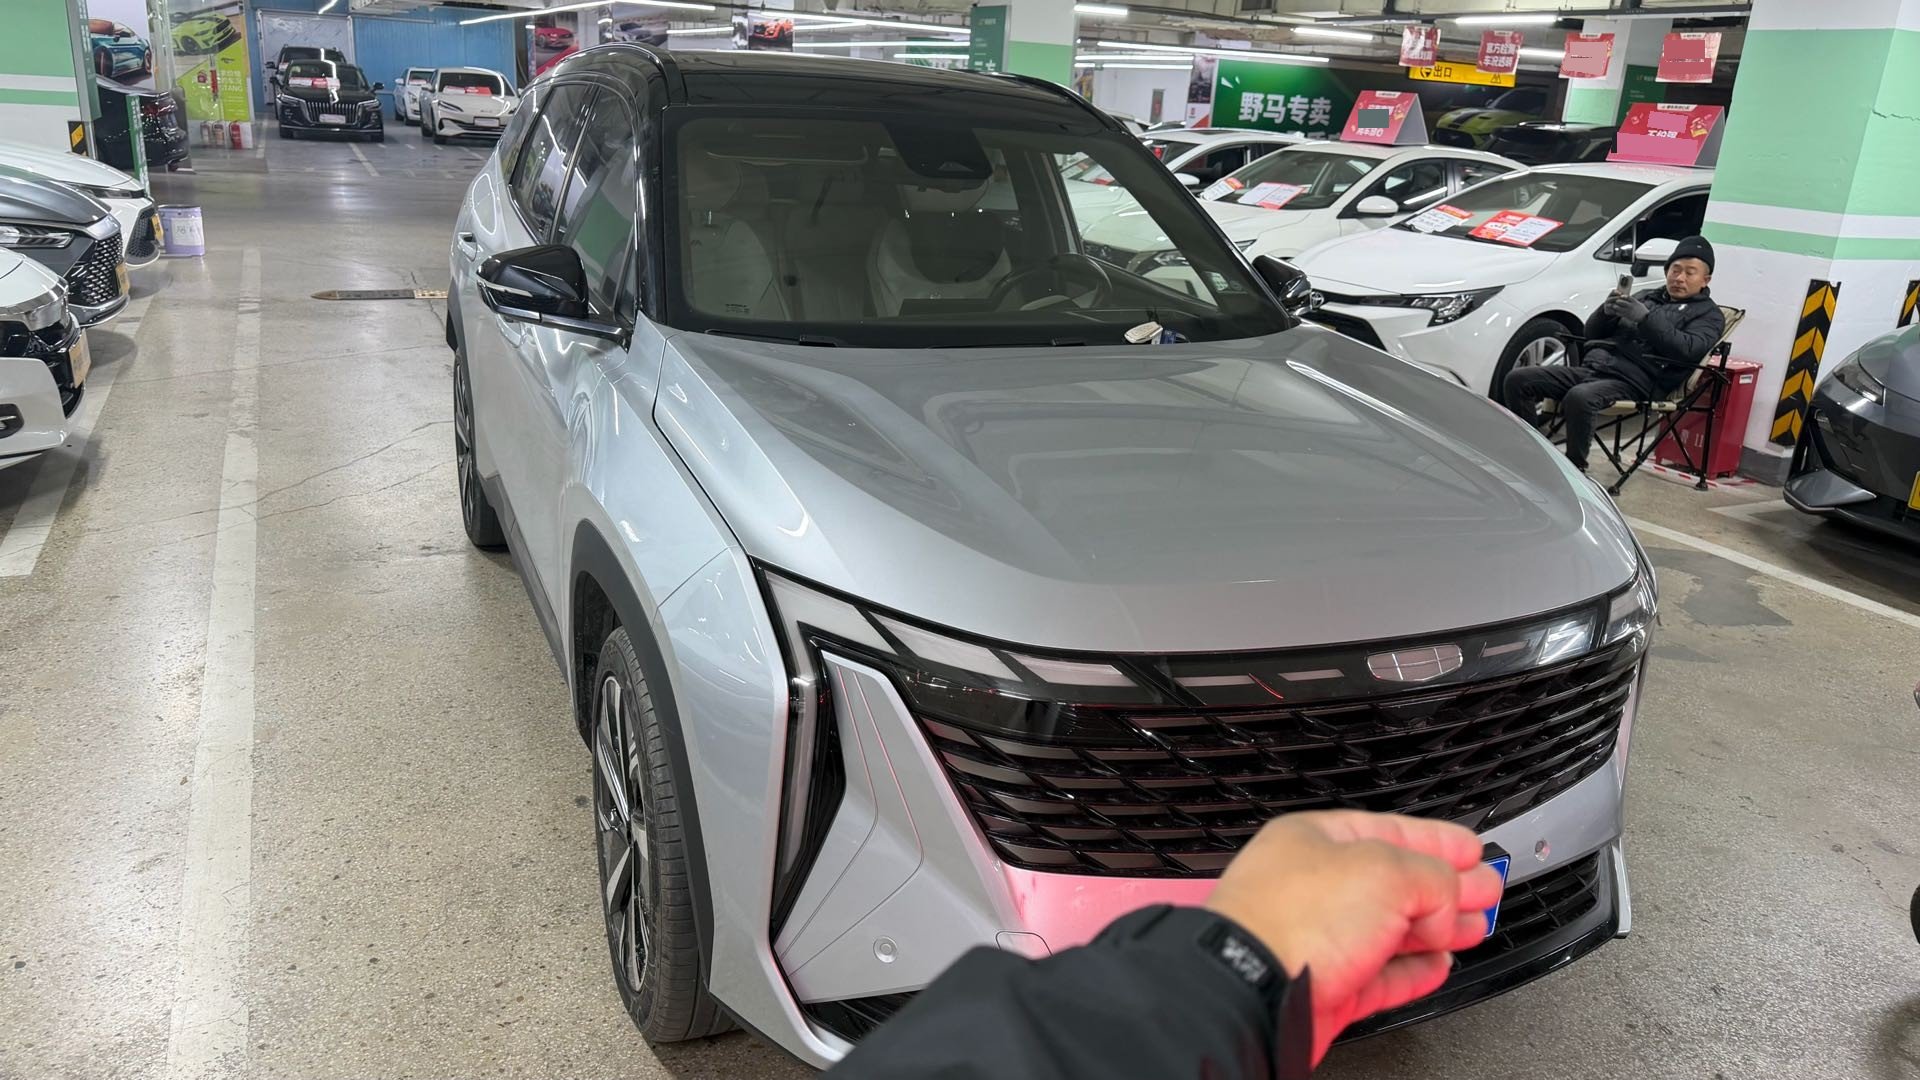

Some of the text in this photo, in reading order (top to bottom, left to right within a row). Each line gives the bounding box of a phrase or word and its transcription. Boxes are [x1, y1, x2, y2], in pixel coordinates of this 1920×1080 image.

[1433, 65, 1452, 78] 出口
[1238, 91, 1332, 126] 野马专卖
